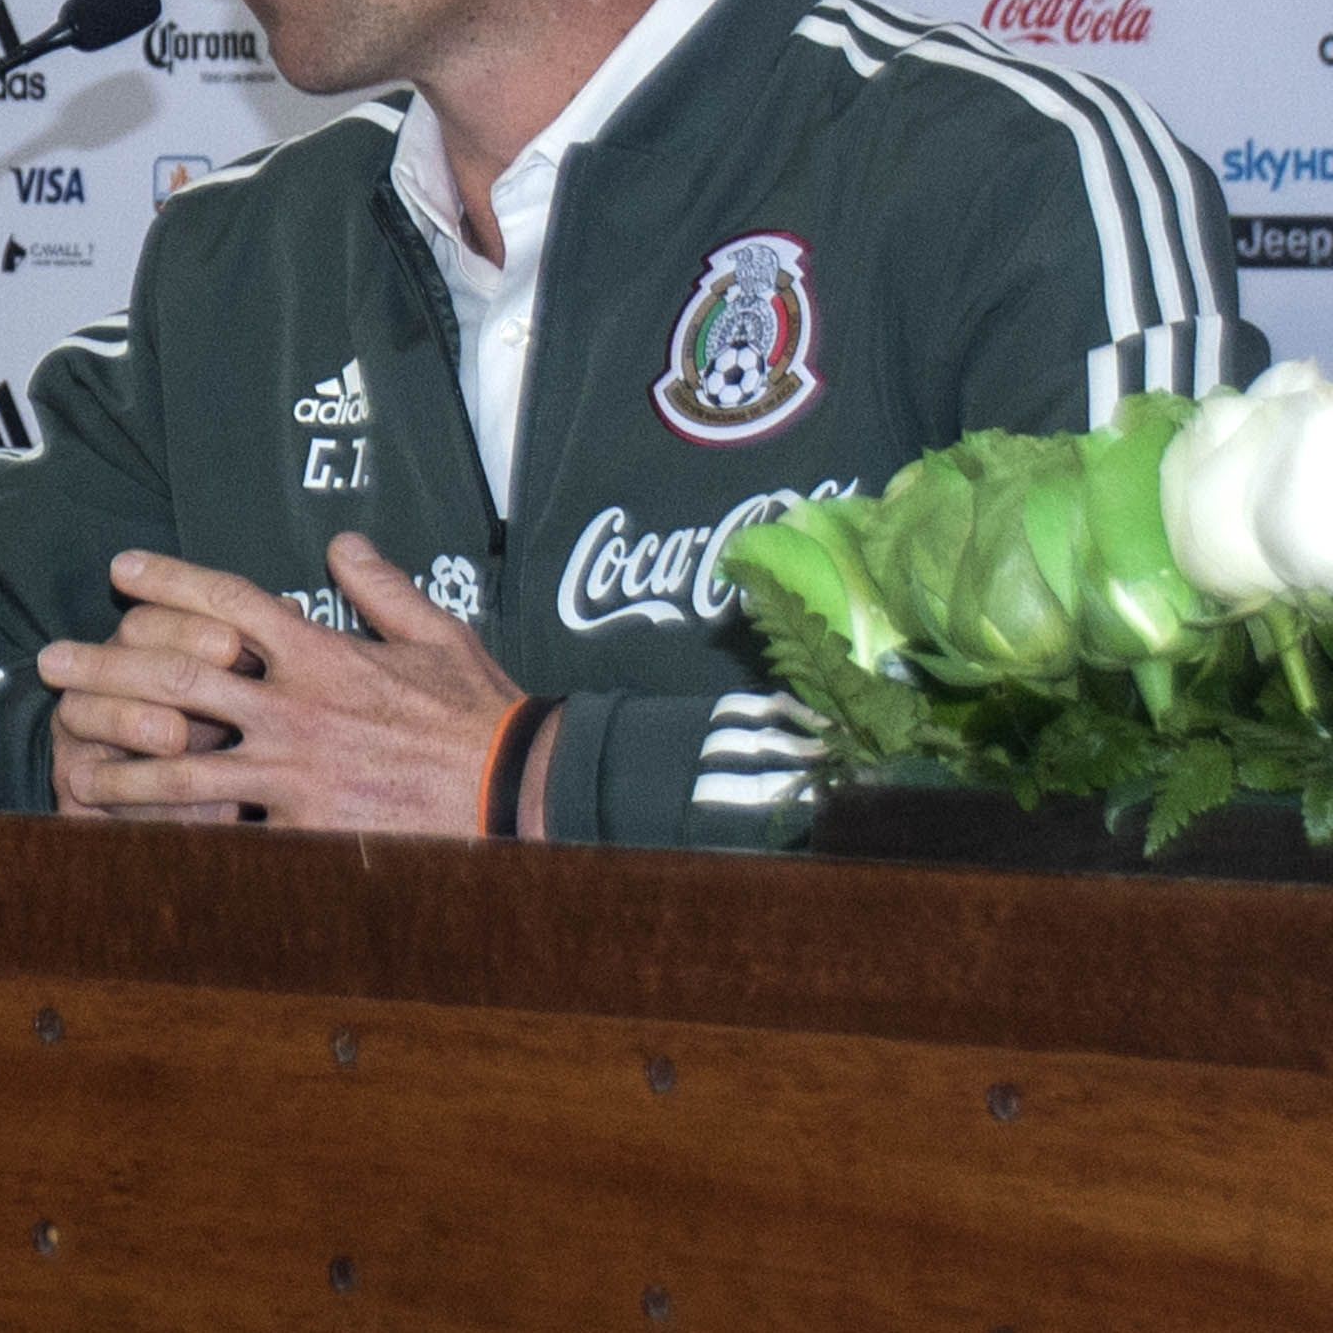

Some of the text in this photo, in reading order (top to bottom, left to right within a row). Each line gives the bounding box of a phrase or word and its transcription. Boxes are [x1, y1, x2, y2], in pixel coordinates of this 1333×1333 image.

[144, 23, 261, 74] Corona
[9, 164, 85, 204] VISA
[1237, 220, 1333, 266] Jeep
